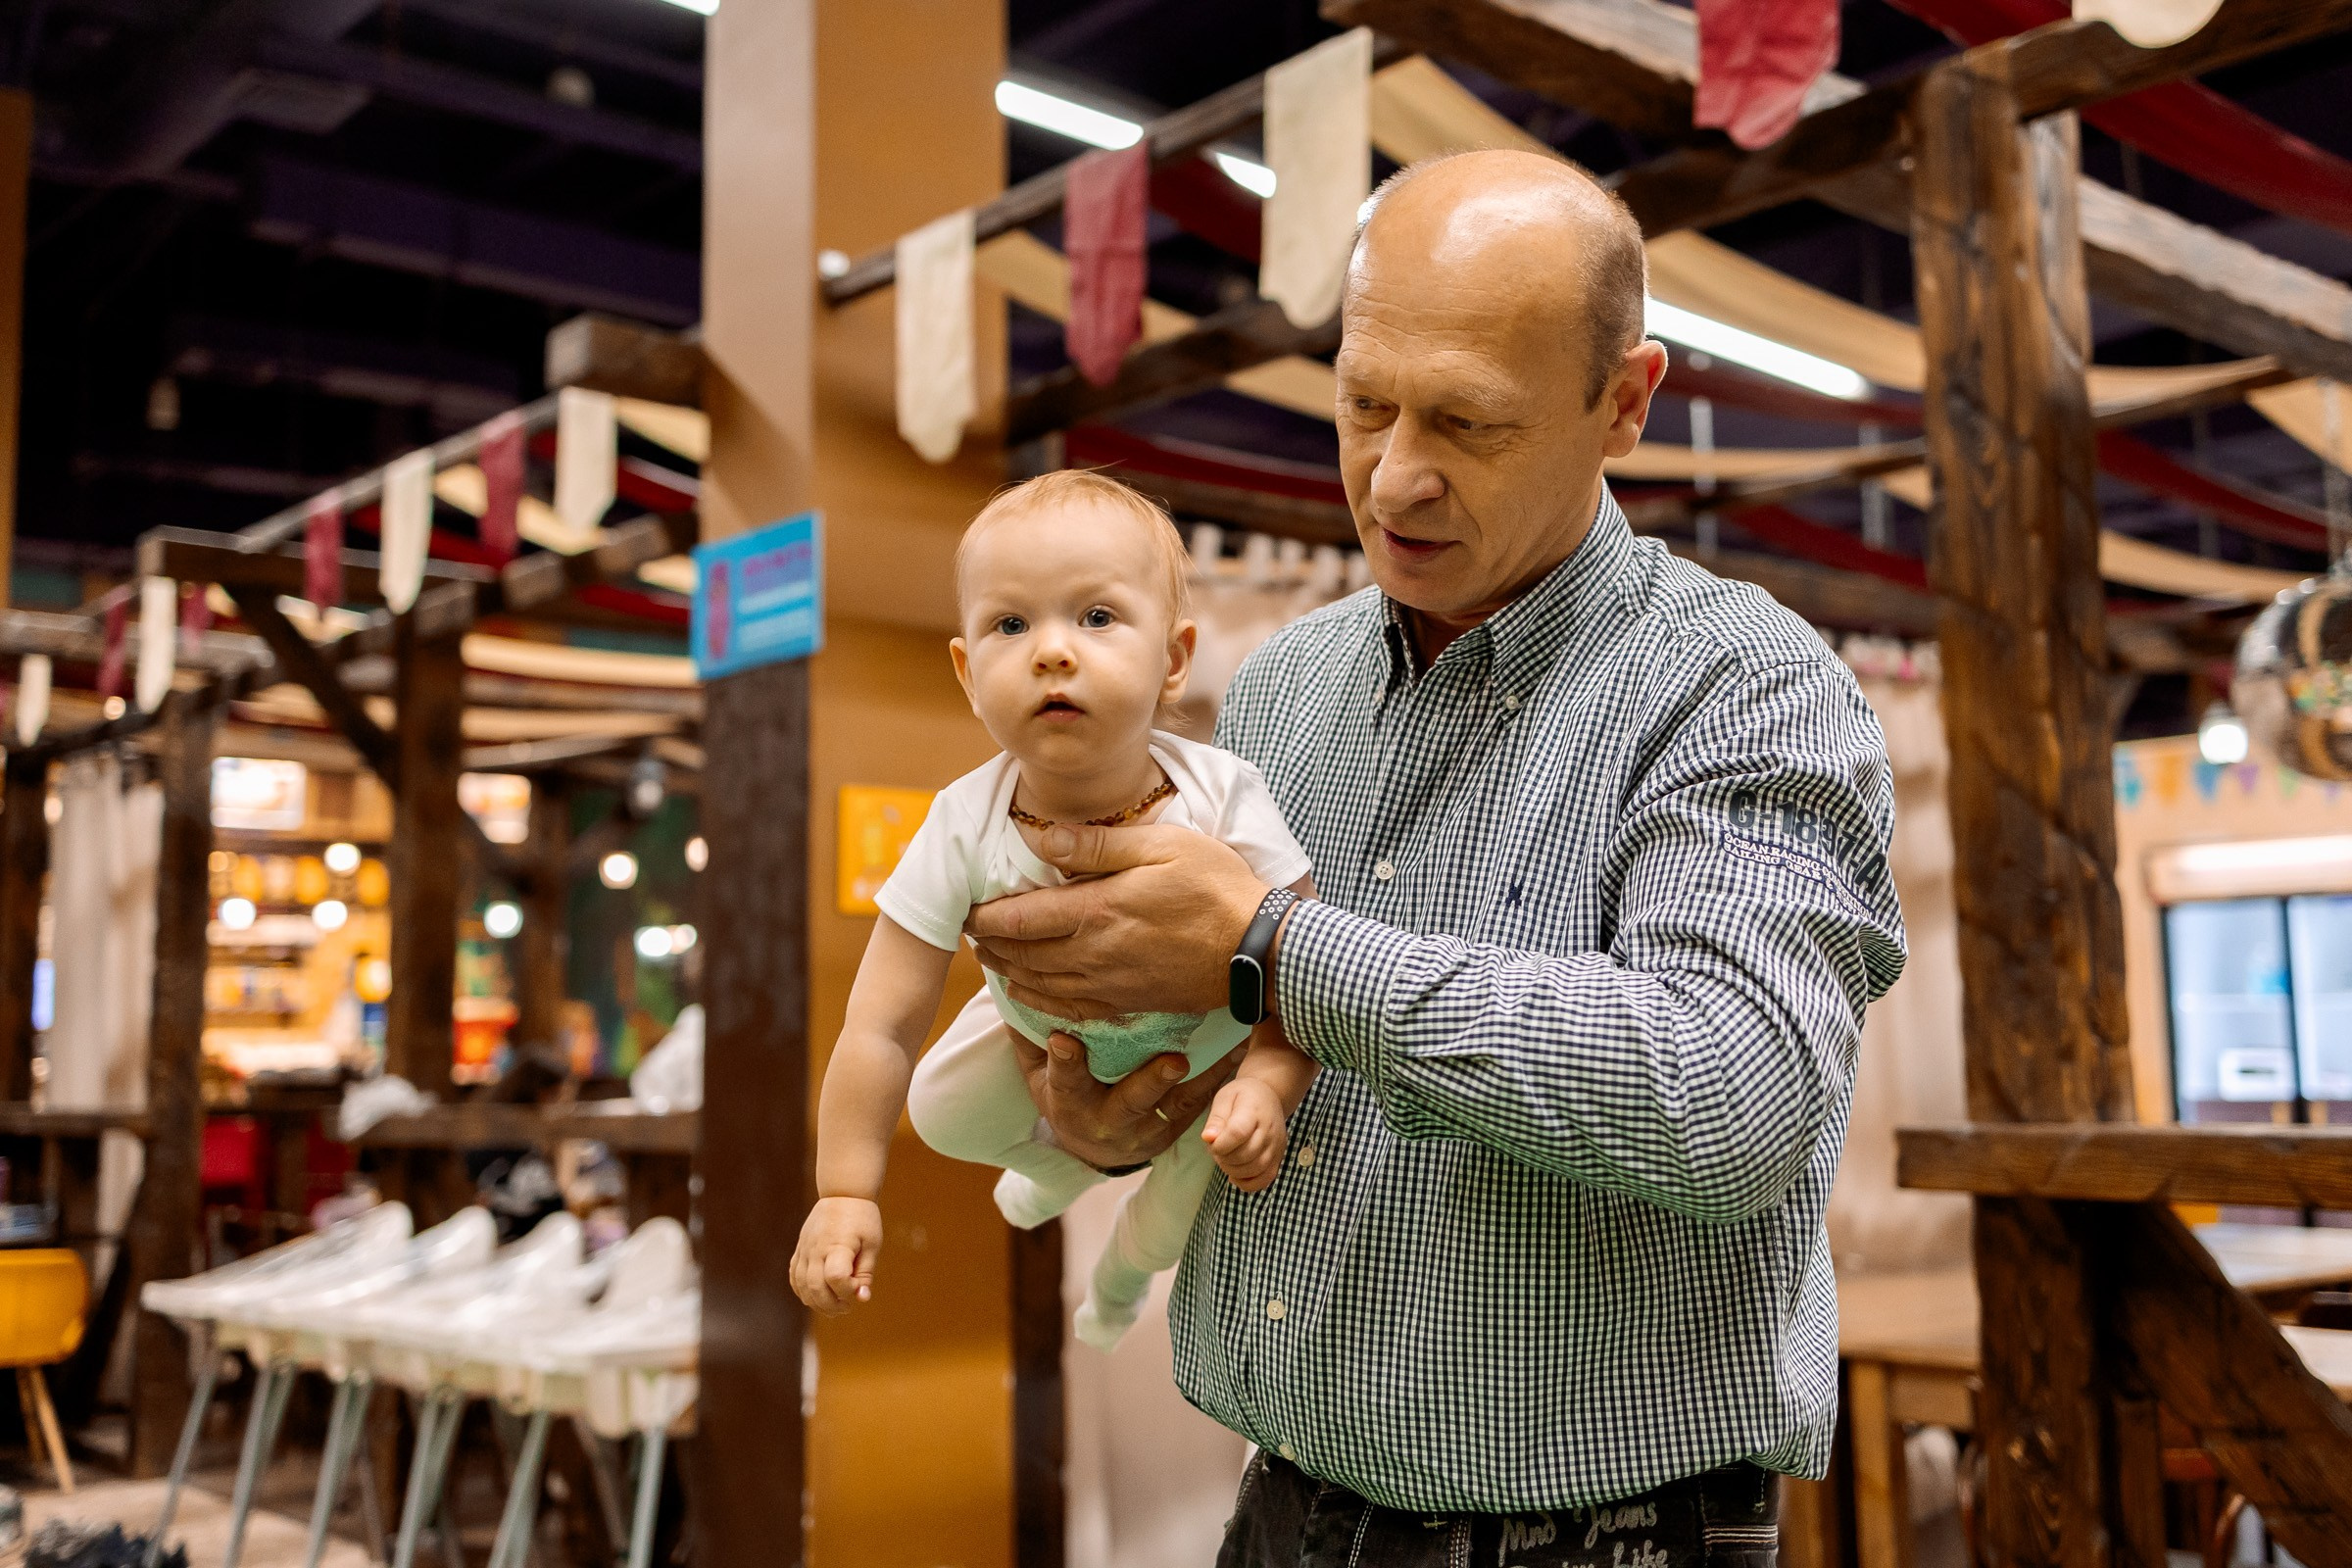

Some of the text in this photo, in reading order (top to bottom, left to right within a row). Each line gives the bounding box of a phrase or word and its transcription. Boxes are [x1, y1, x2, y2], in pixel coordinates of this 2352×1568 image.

[1724, 832, 1770, 856] OCEAN
[1770, 847, 1823, 871] RACING
[1724, 842, 1781, 864] SAILING
[1786, 859, 1823, 880] GEAR
[1574, 1501, 1657, 1549] Jeans
